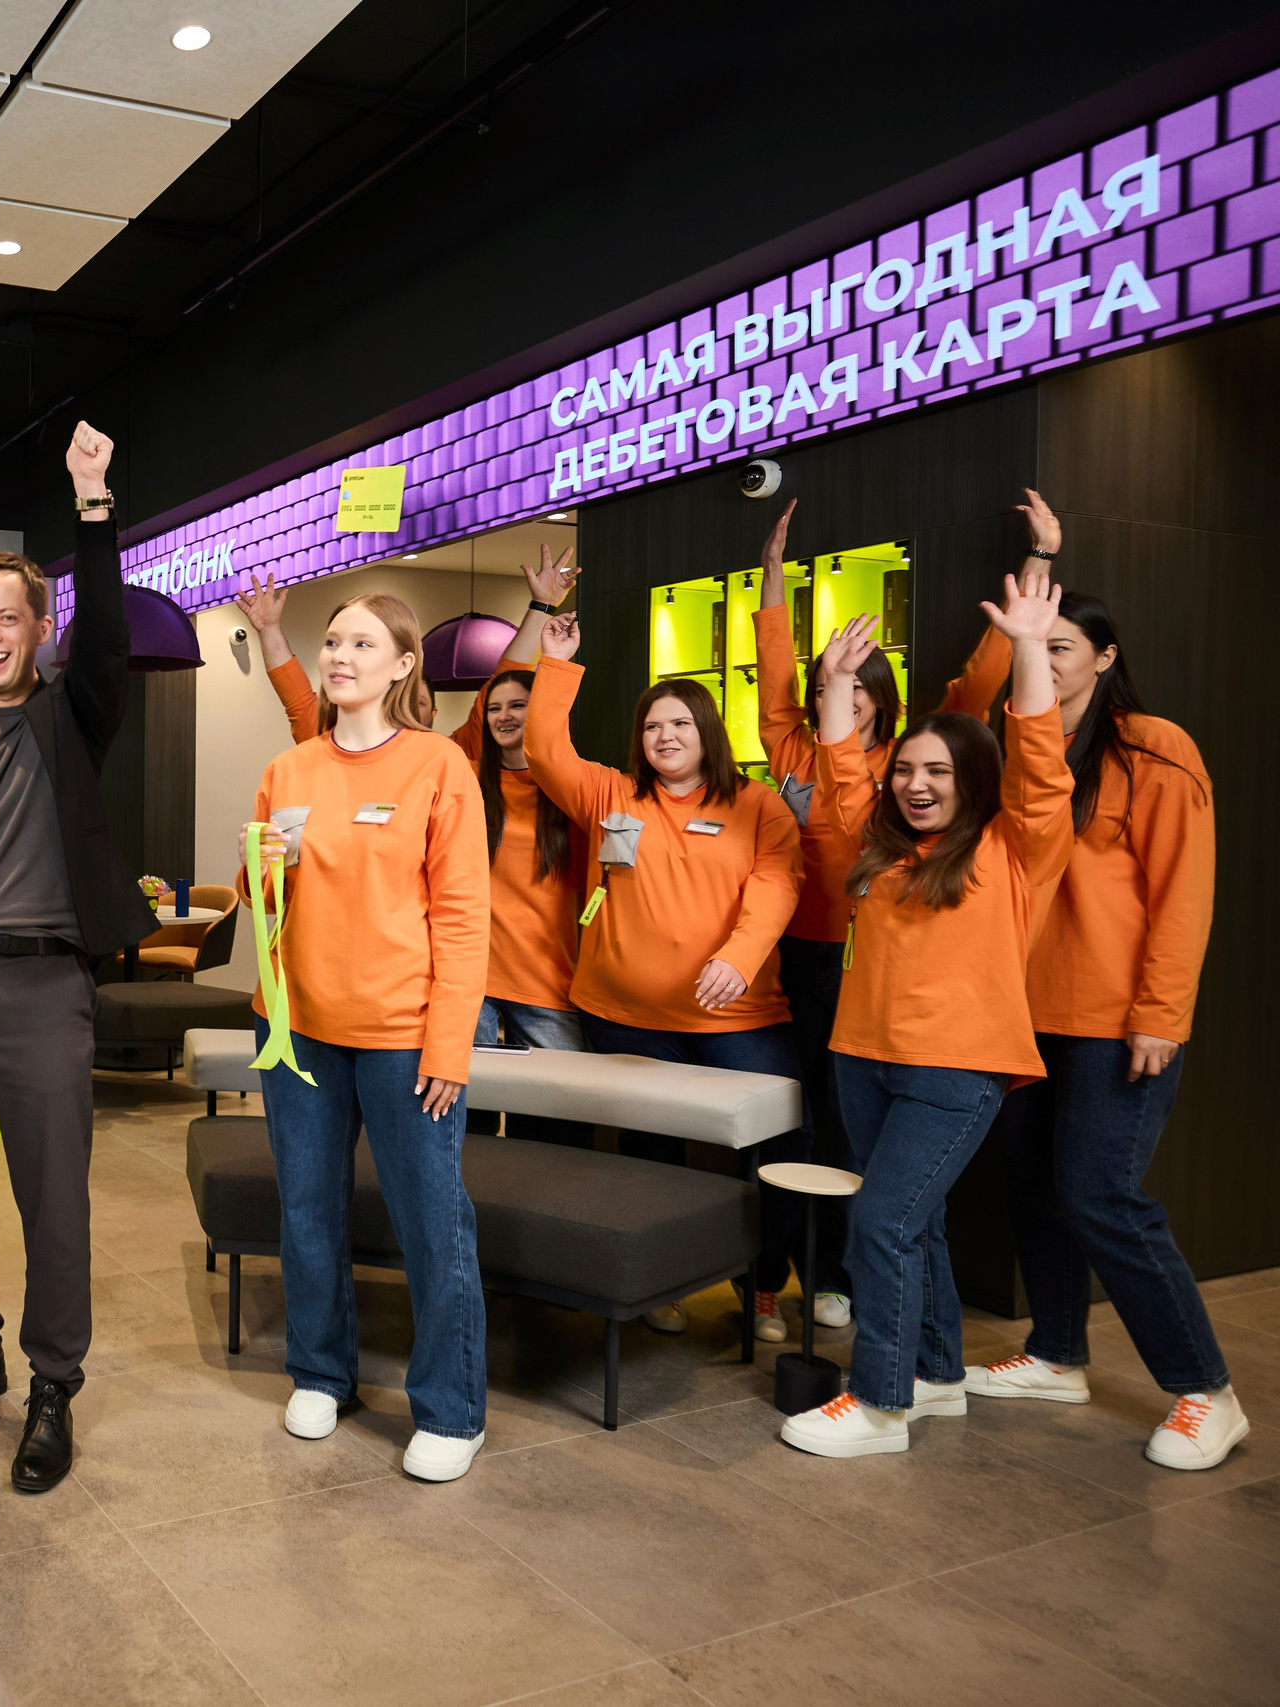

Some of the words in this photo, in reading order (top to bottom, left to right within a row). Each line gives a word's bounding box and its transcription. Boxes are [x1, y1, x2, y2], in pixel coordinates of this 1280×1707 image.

[549, 353, 859, 499] ДЕБЕТОВАЯ
[882, 261, 1162, 392] КАРТА
[550, 331, 715, 427] САМАЯ
[734, 154, 1161, 364] ВЫГОДНАЯ
